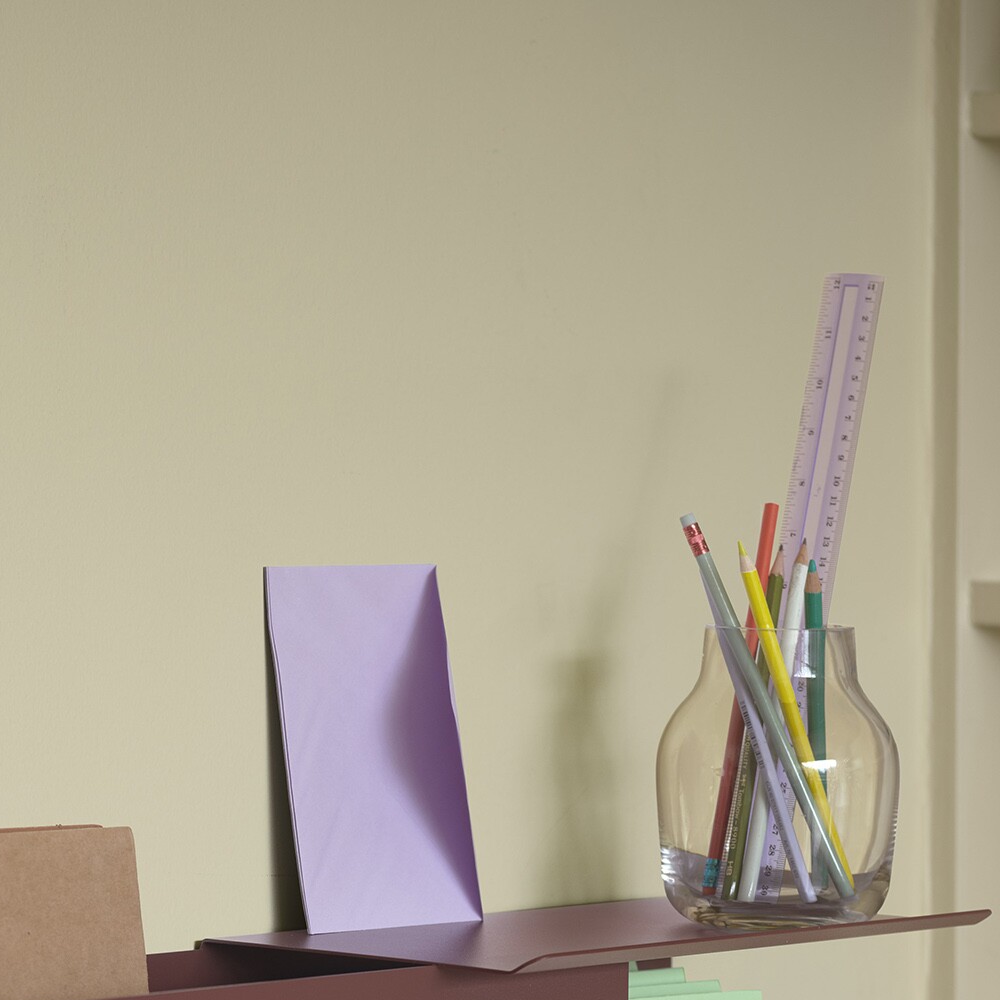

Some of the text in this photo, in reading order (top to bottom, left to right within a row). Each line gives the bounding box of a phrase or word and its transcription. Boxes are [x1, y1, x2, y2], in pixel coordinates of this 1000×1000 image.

[816, 379, 823, 389] 10
[825, 330, 832, 339] 11
[833, 279, 841, 289] 12
[833, 476, 841, 487] 10
[829, 496, 838, 506] 11
[826, 516, 834, 527] 12
[823, 536, 831, 548] 13
[819, 557, 827, 567] 14
[797, 681, 804, 692] 20
[771, 823, 779, 835] 27
[730, 826, 738, 850] 8900
[768, 844, 776, 856] 28
[726, 860, 734, 876] HB
[764, 865, 772, 877] 29
[761, 884, 769, 896] 30
